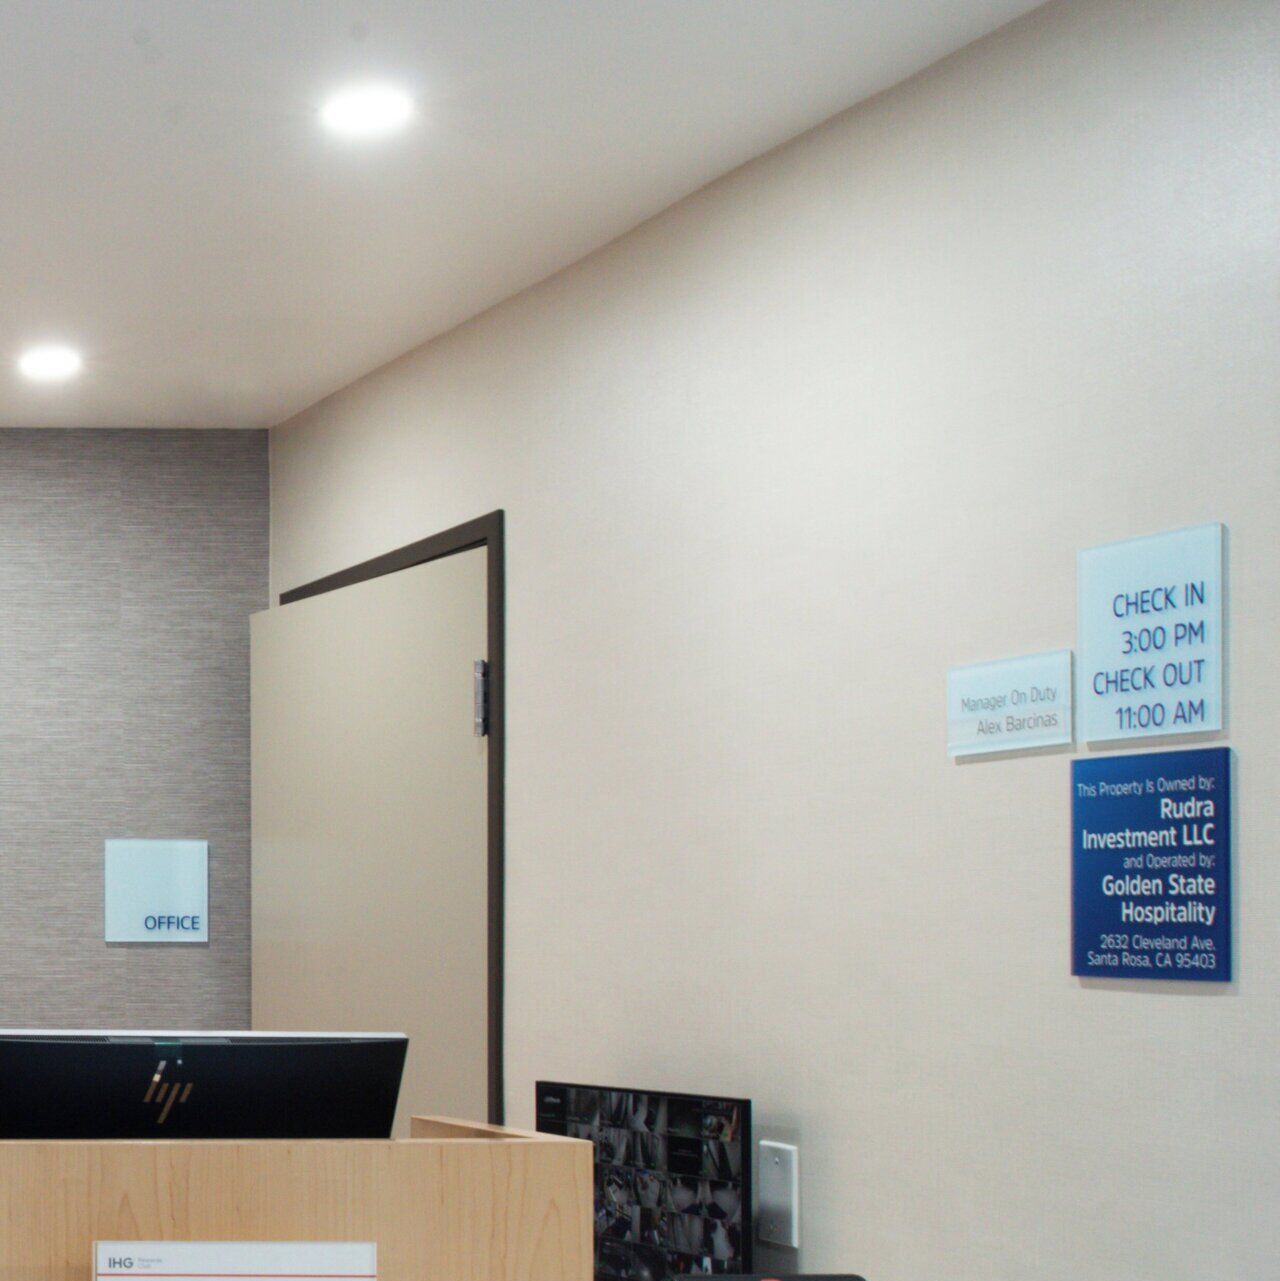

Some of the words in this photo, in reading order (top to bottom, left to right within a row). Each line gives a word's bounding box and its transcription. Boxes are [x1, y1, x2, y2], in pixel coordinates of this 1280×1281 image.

[1113, 581, 1177, 618] CHECK
[1185, 580, 1205, 608] IN
[1122, 625, 1167, 655] 3:00
[1174, 620, 1205, 648] PM
[1093, 664, 1156, 696] CHECK
[1163, 659, 1206, 688] OUT
[961, 694, 1008, 713] Manager
[1011, 689, 1028, 706] On
[1030, 686, 1058, 703] Duty
[976, 719, 1003, 736] Alex
[1006, 713, 1059, 733] Barcinas
[1115, 702, 1166, 731] 11:00
[1173, 698, 1205, 725] AM
[1077, 783, 1097, 798] This
[1099, 780, 1144, 797] Property
[1157, 776, 1196, 792] Owned
[1198, 774, 1216, 792] by:
[1160, 796, 1215, 820] Rudra
[1082, 825, 1178, 850] Investment
[1182, 822, 1216, 846] LLC
[1123, 856, 1143, 870] and
[1146, 852, 1196, 870] Operated
[1198, 851, 1216, 869] by:
[1101, 874, 1163, 897] Golden
[1168, 872, 1216, 896] State
[144, 915, 200, 930] OFFICE
[1121, 900, 1217, 927] Hospitality
[1099, 934, 1129, 950] 2632
[1132, 934, 1188, 951] Cleveland
[1087, 951, 1120, 967] Santa
[1155, 952, 1173, 967] CA
[1175, 953, 1217, 969] 95403
[108, 1257, 134, 1269] IHG
